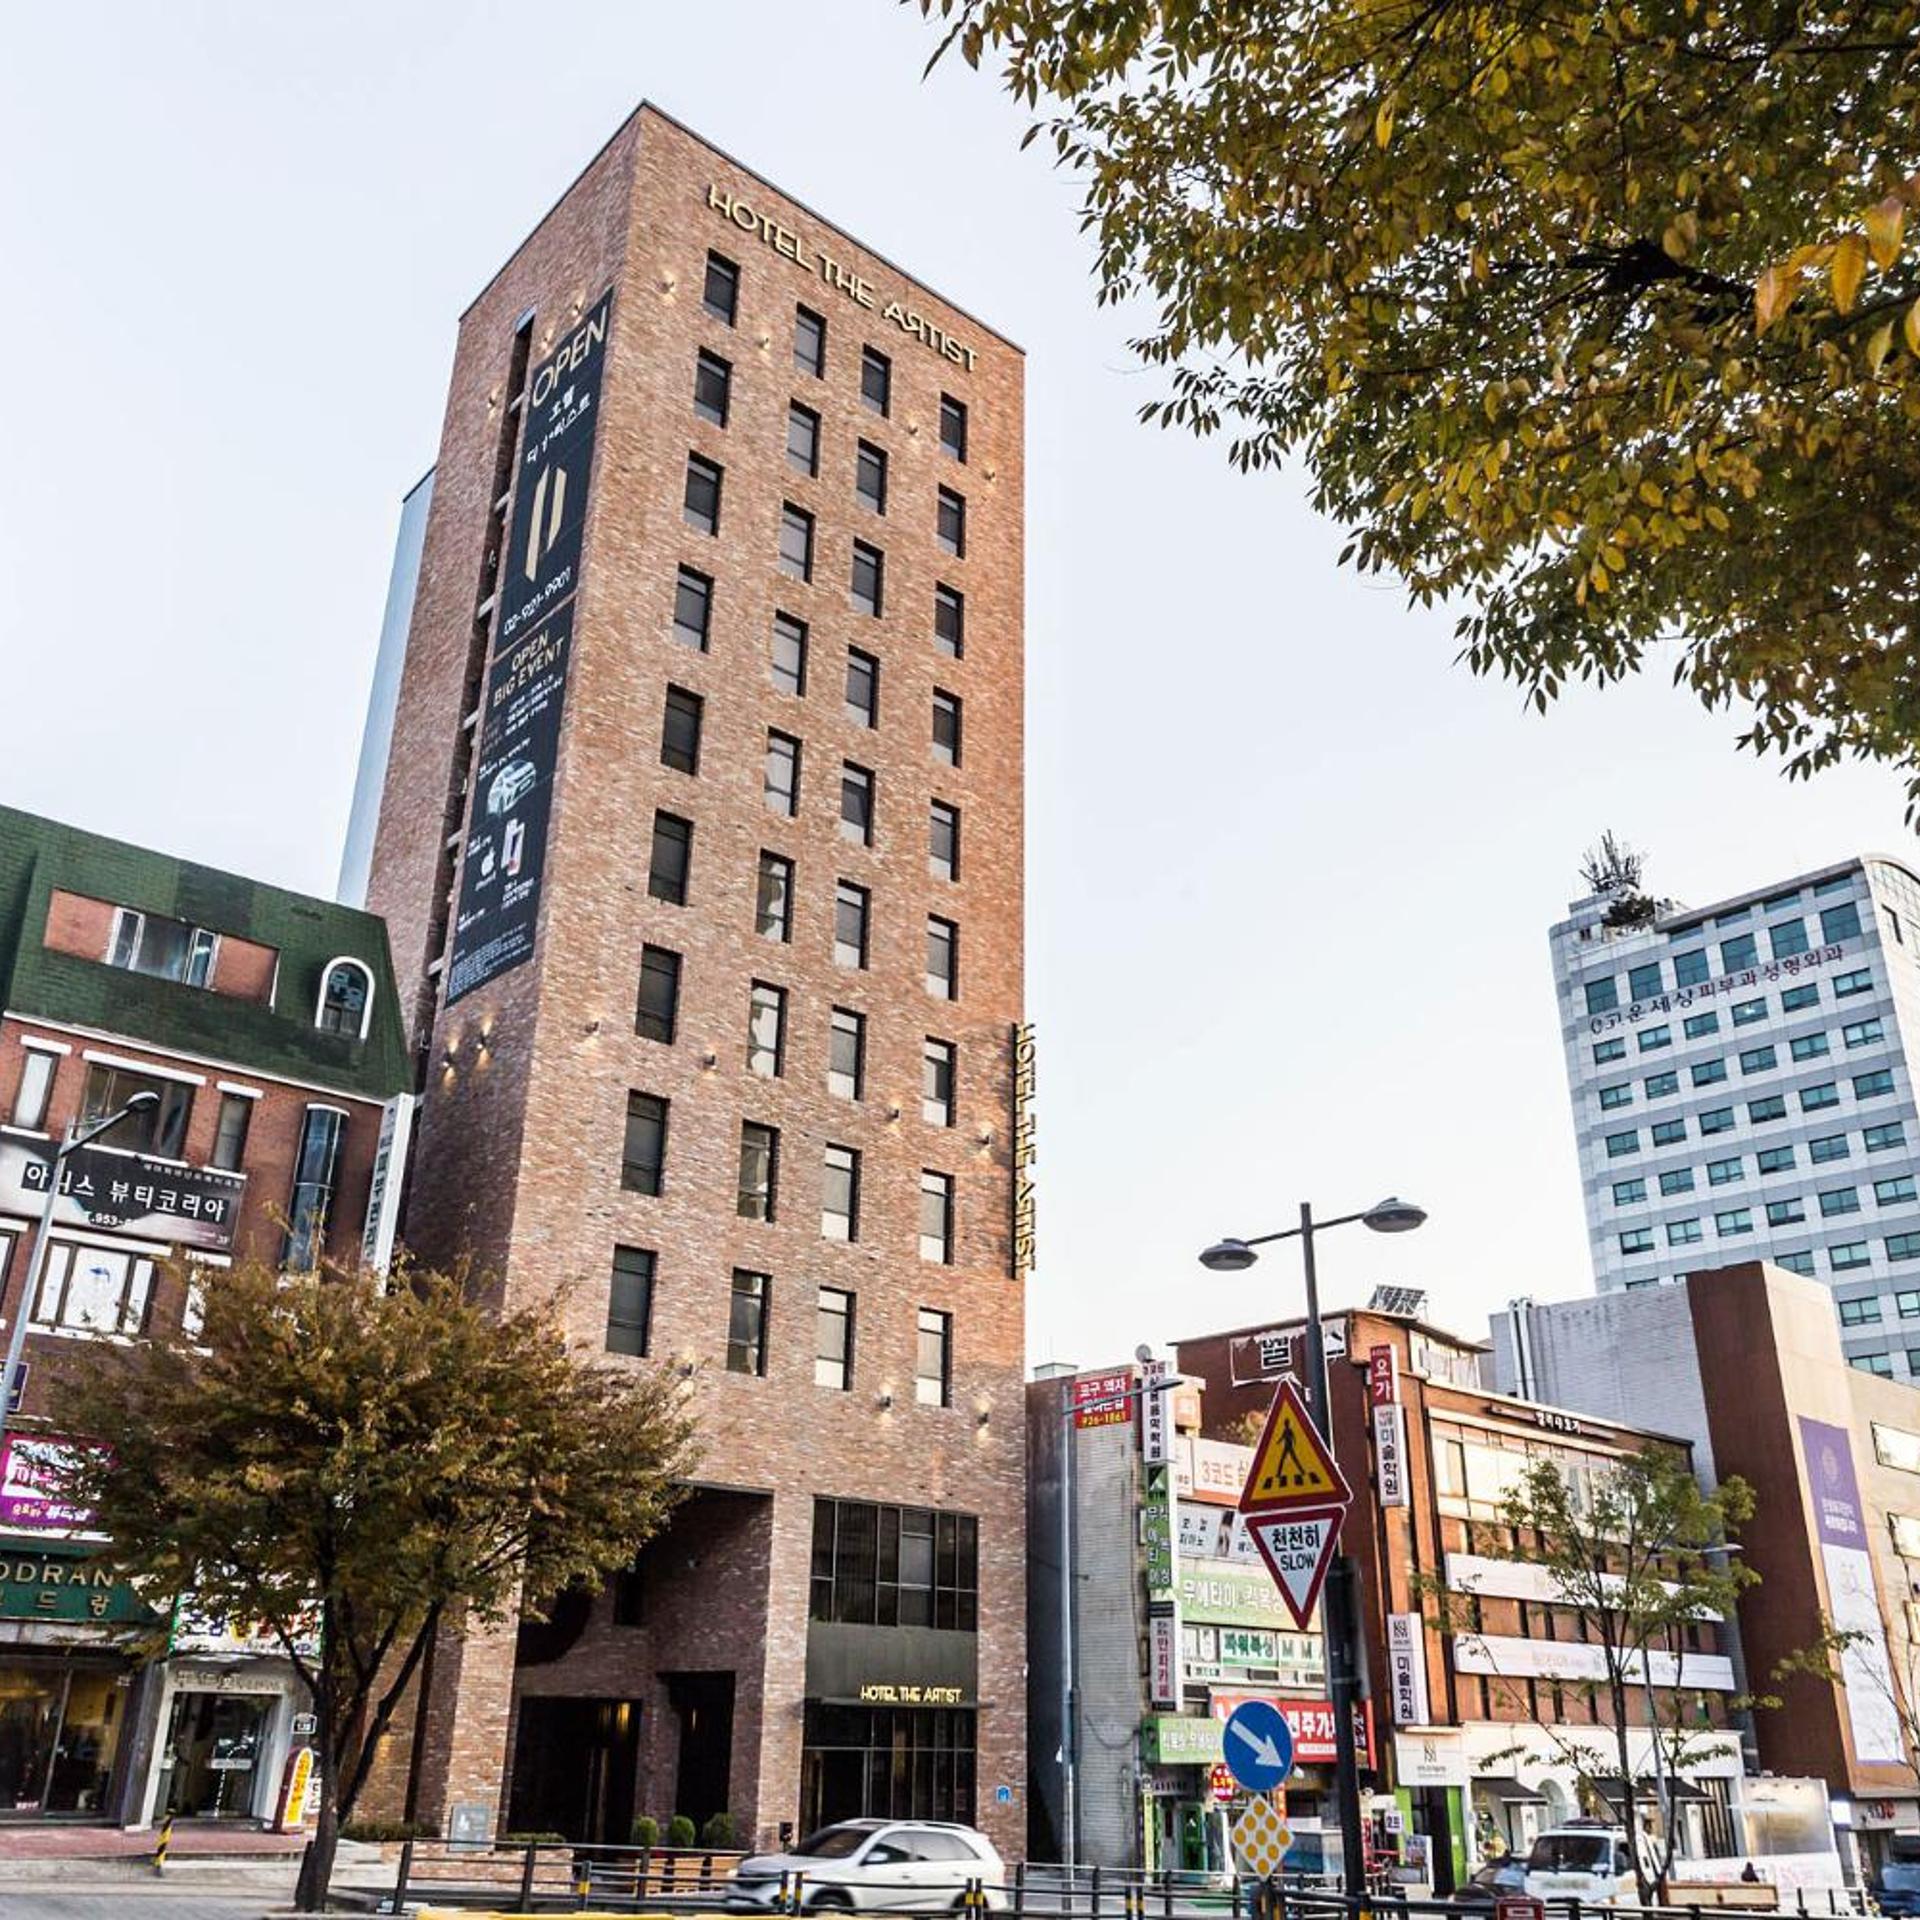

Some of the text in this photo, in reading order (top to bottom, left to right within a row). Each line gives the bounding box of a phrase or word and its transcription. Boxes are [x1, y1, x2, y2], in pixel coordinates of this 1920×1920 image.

[708, 184, 979, 371] HOTEL THE ARTIST
[532, 305, 608, 408] OPEN
[493, 679, 516, 708] BIG
[518, 636, 565, 688] EVENT
[512, 630, 549, 672] OPEN
[109, 1180, 225, 1222] 뷰티코리아
[1271, 1523, 1321, 1552] 천천히
[1279, 1551, 1317, 1572] SLOW
[860, 1685, 962, 1703] HOTEL THE ARTIST
